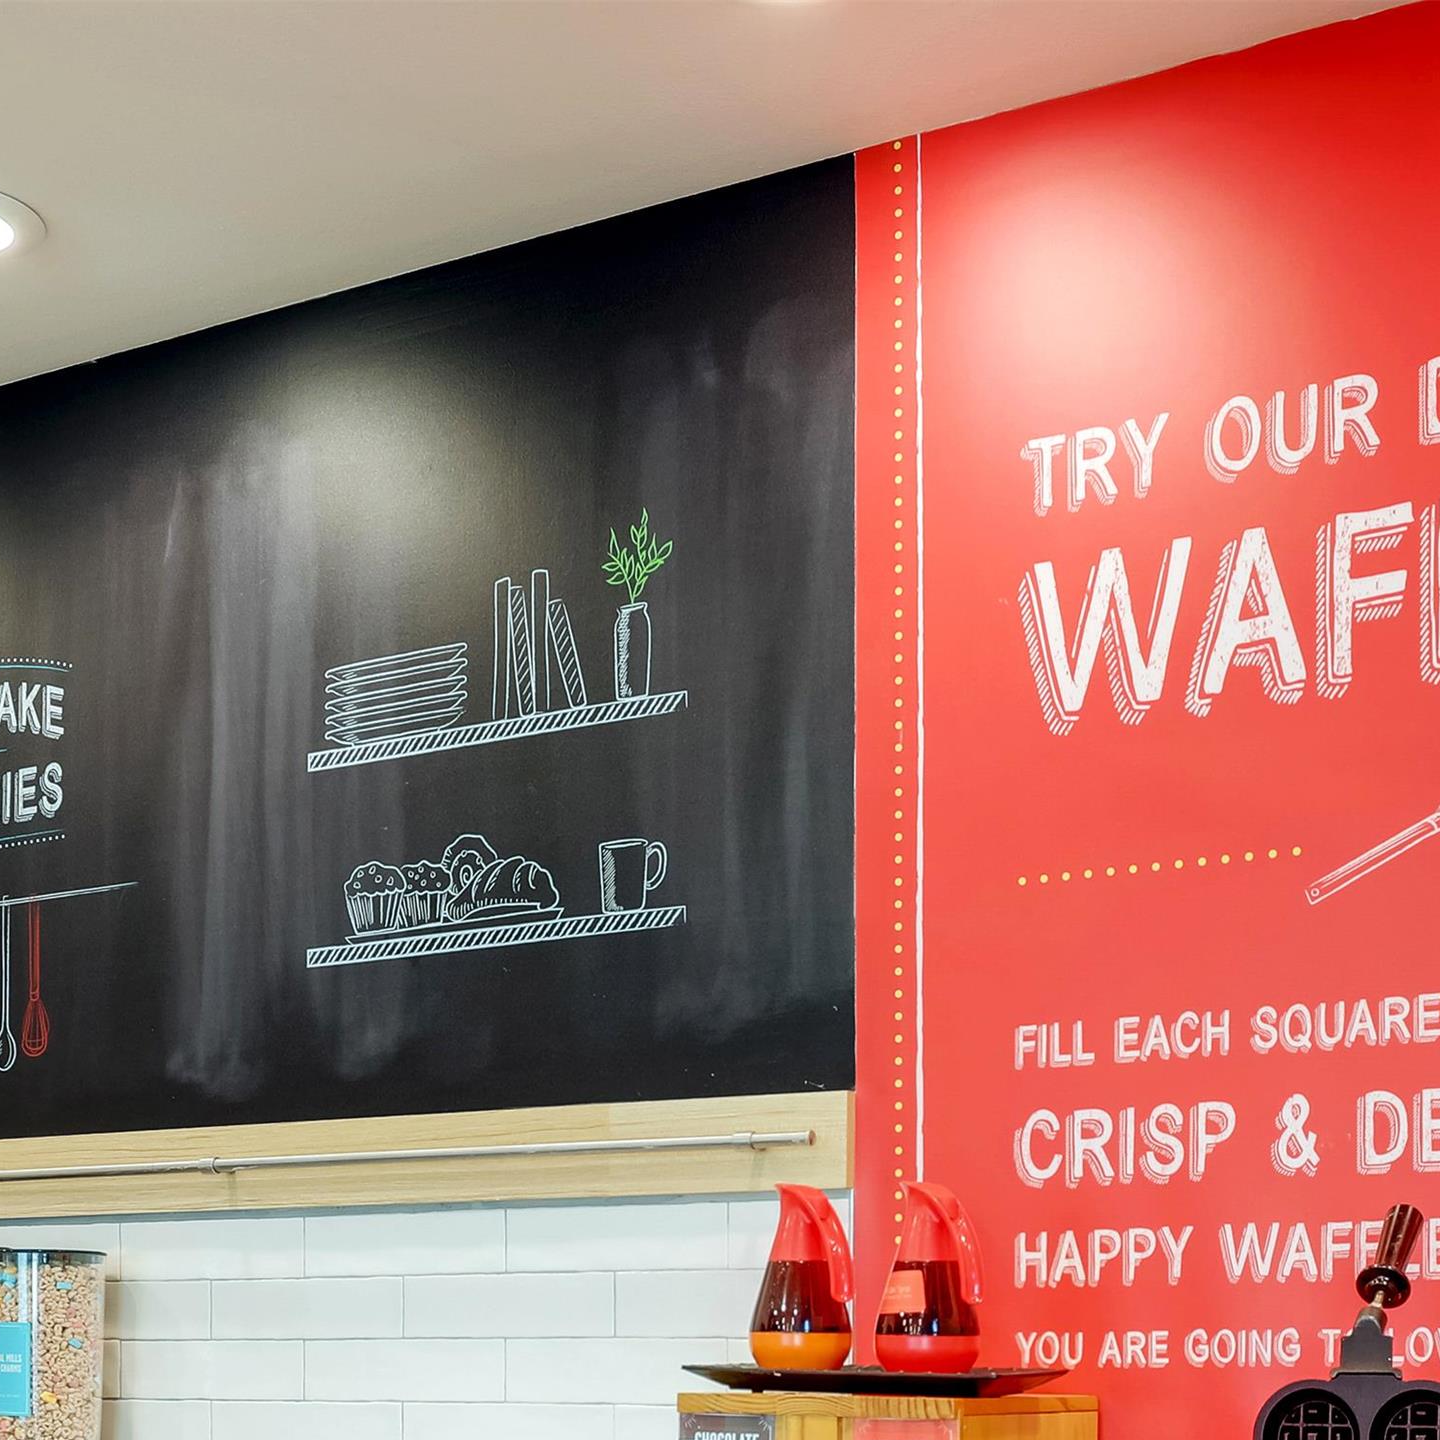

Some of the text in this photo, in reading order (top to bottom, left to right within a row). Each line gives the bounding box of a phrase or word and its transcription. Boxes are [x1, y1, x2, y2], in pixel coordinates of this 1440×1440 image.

[1020, 412, 1169, 517] TRY
[1203, 374, 1380, 484] OUR
[1014, 1020, 1095, 1070] FILL
[1114, 1009, 1230, 1063] EACH
[1013, 1101, 1236, 1189] CRISP
[1270, 1093, 1321, 1177] &
[1014, 1225, 1194, 1288] HAPPY
[1015, 1331, 1084, 1370] YOU
[1098, 1330, 1170, 1367] ARE
[1184, 1327, 1302, 1368] GOING
